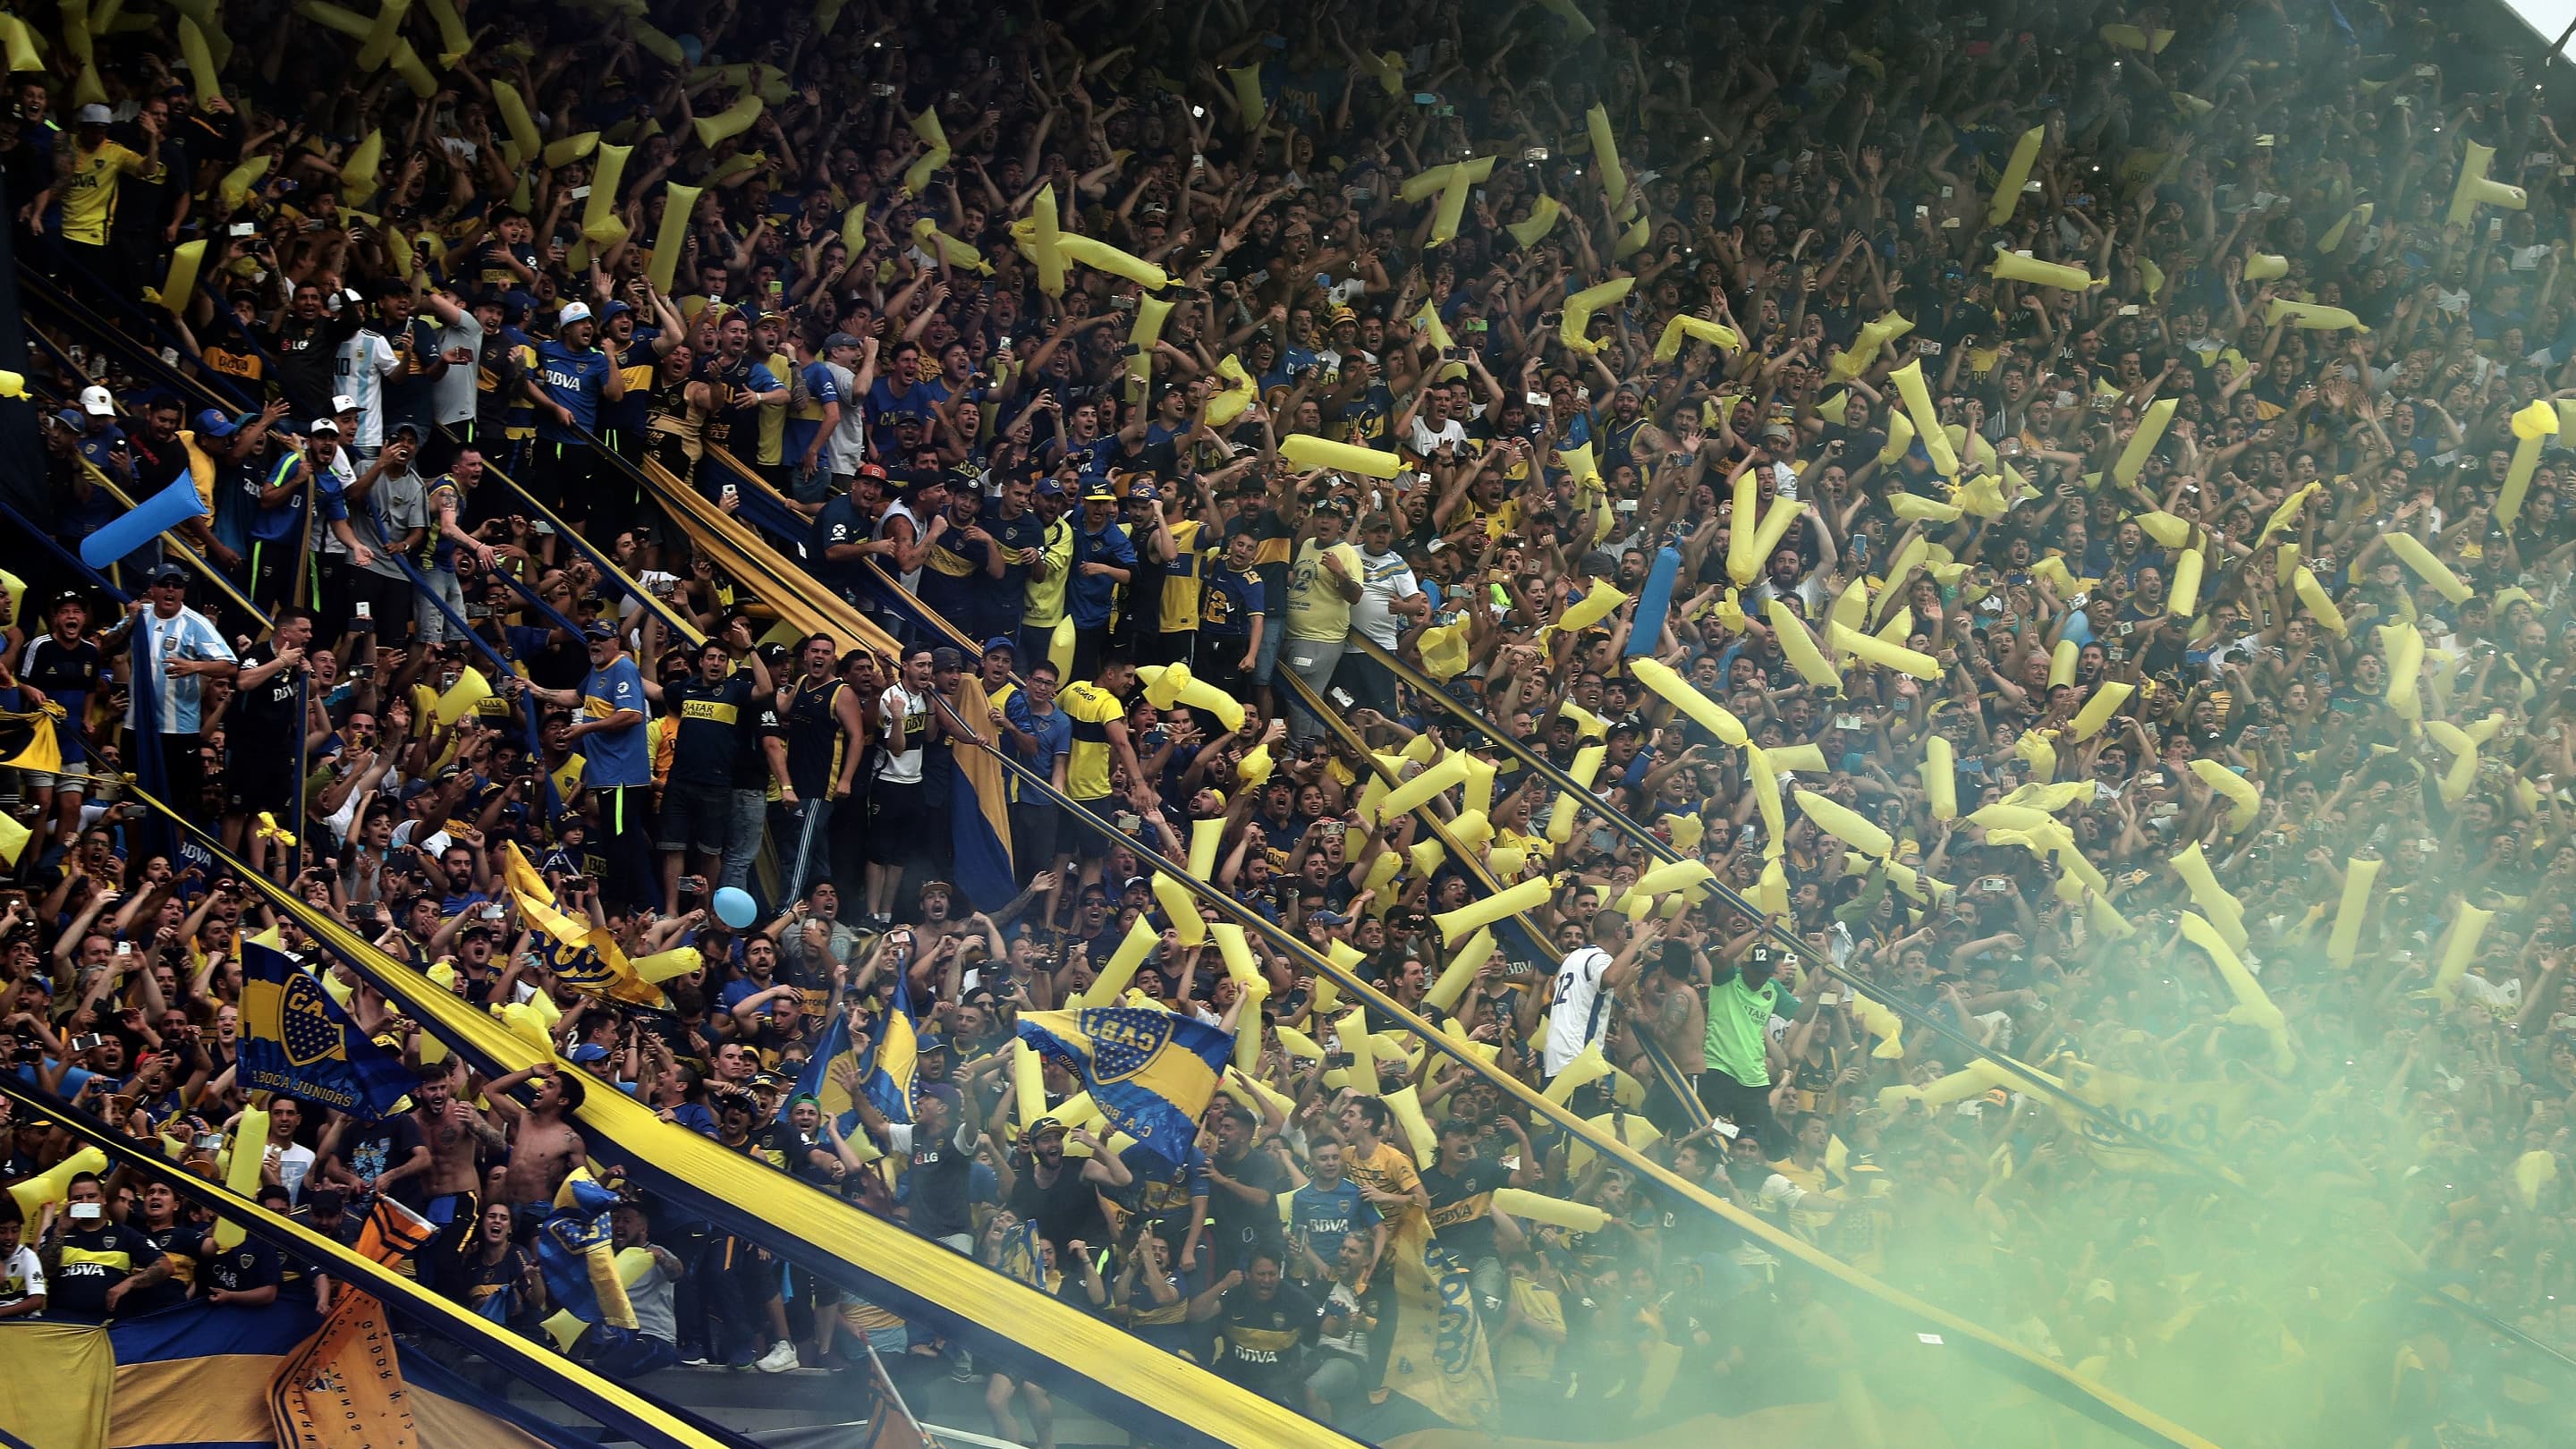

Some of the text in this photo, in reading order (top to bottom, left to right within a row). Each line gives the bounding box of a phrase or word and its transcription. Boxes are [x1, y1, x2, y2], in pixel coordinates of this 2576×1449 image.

[546, 369, 581, 392] BBVA
[682, 702, 715, 714] QATAR
[1755, 949, 1767, 962] 12
[1554, 972, 1574, 1006] 12
[293, 1080, 353, 1106] JUNIORS
[1309, 1219, 1349, 1233] BBVA
[1235, 1344, 1278, 1364] BBVA
